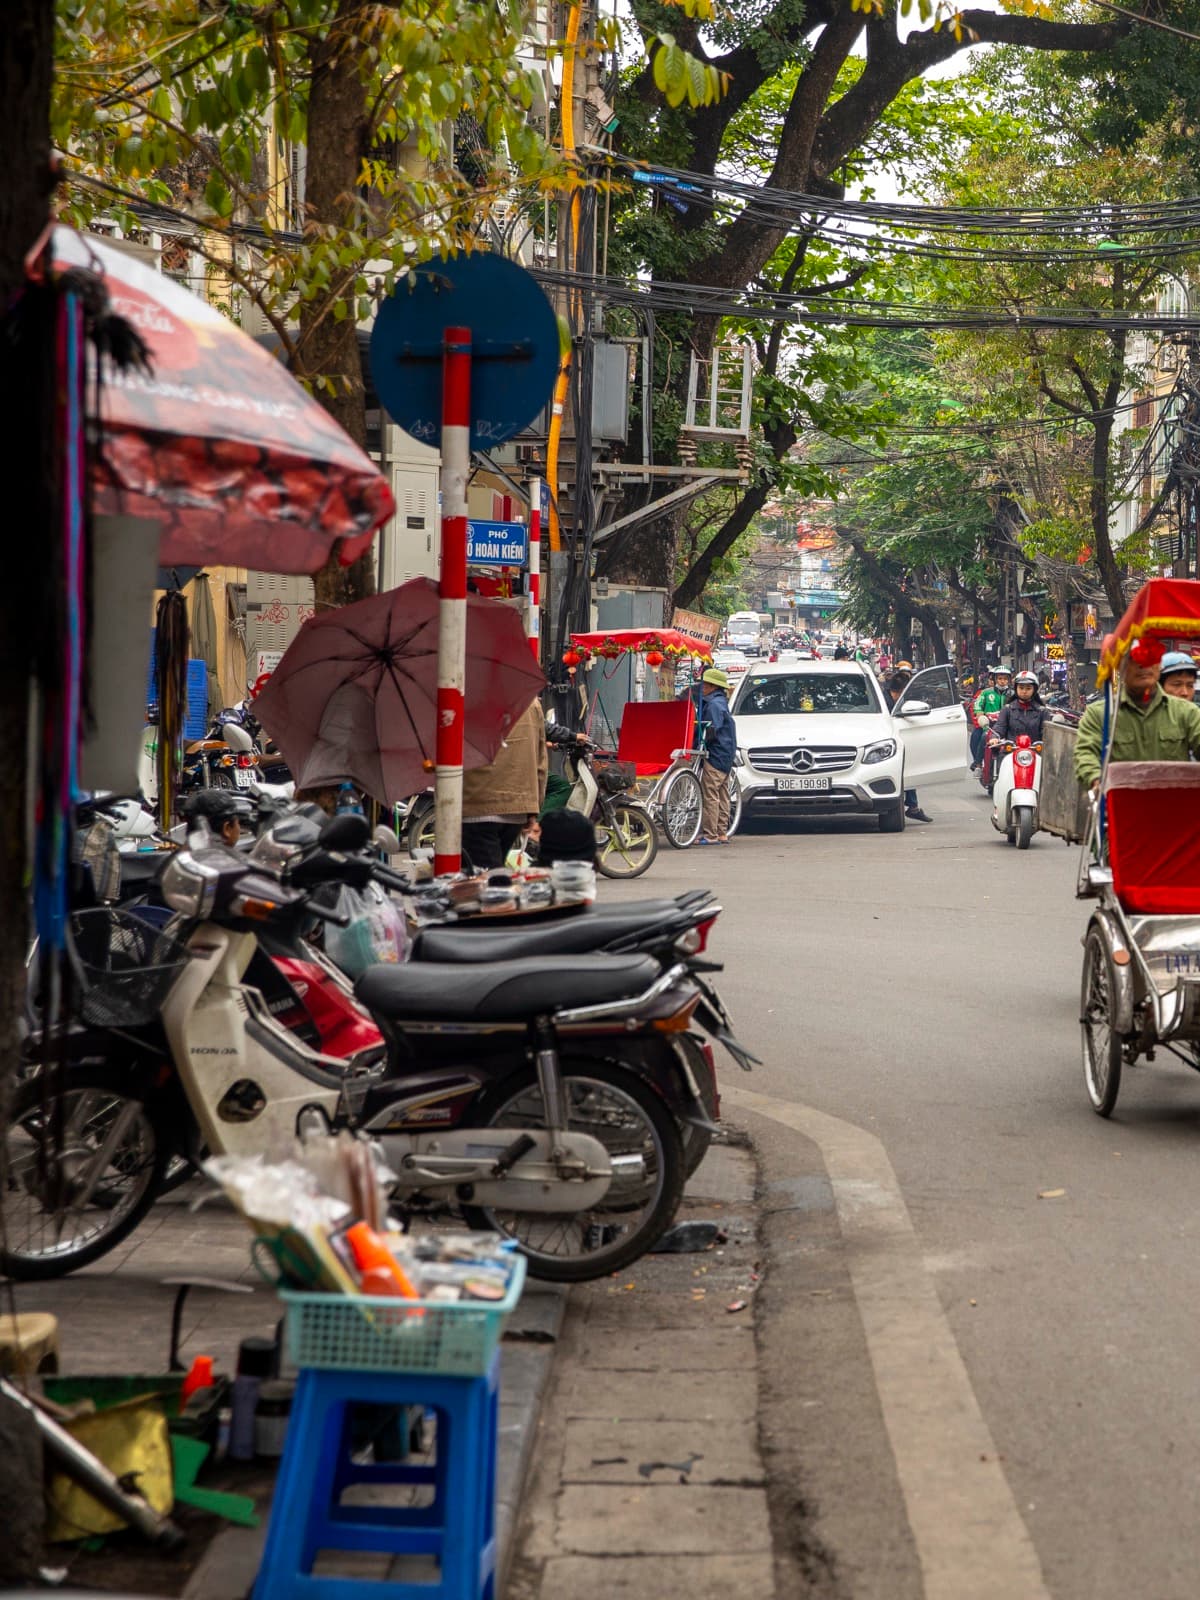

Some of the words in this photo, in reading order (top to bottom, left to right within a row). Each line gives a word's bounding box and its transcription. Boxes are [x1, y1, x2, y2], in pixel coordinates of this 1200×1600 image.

[488, 528, 509, 539] PHỐ
[475, 540, 500, 558] HOÀN
[502, 541, 523, 559] KIẾM
[779, 779, 828, 790] 30E-190.98
